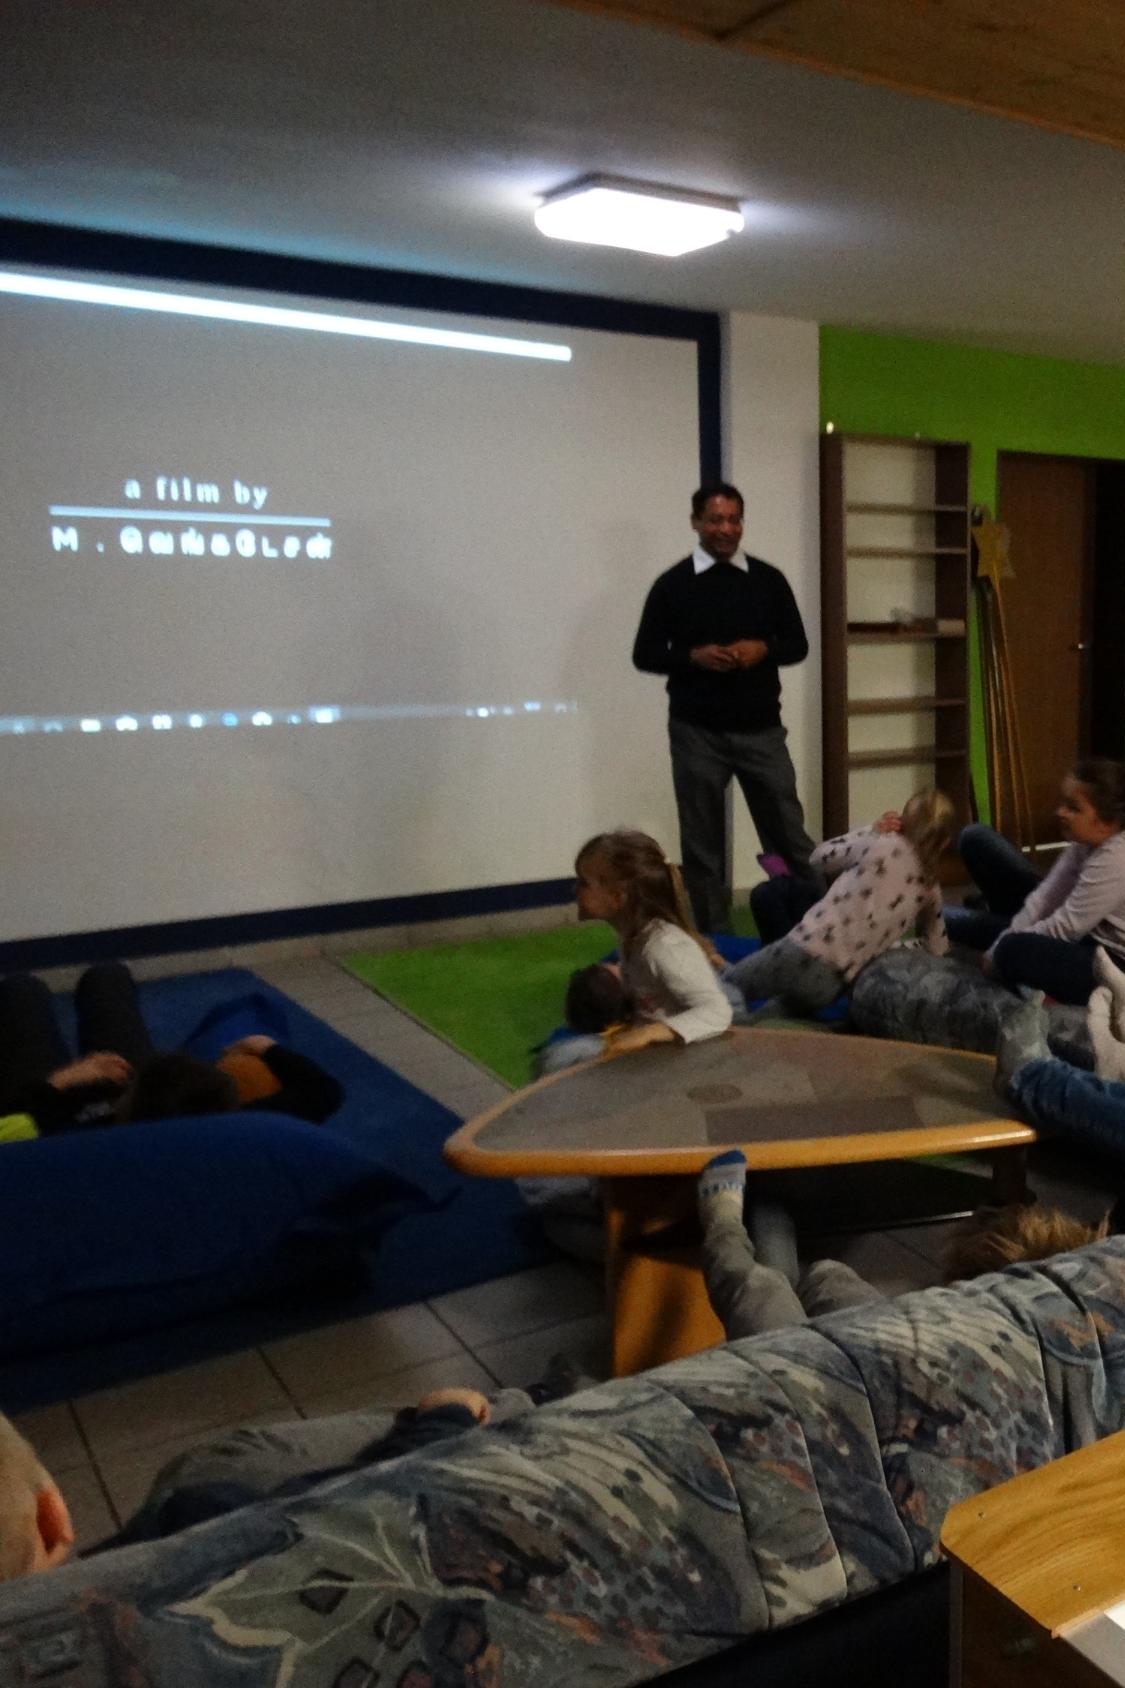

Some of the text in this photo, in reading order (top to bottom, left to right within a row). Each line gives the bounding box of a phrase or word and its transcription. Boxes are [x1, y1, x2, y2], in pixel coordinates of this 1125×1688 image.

[124, 476, 269, 510] a film by
